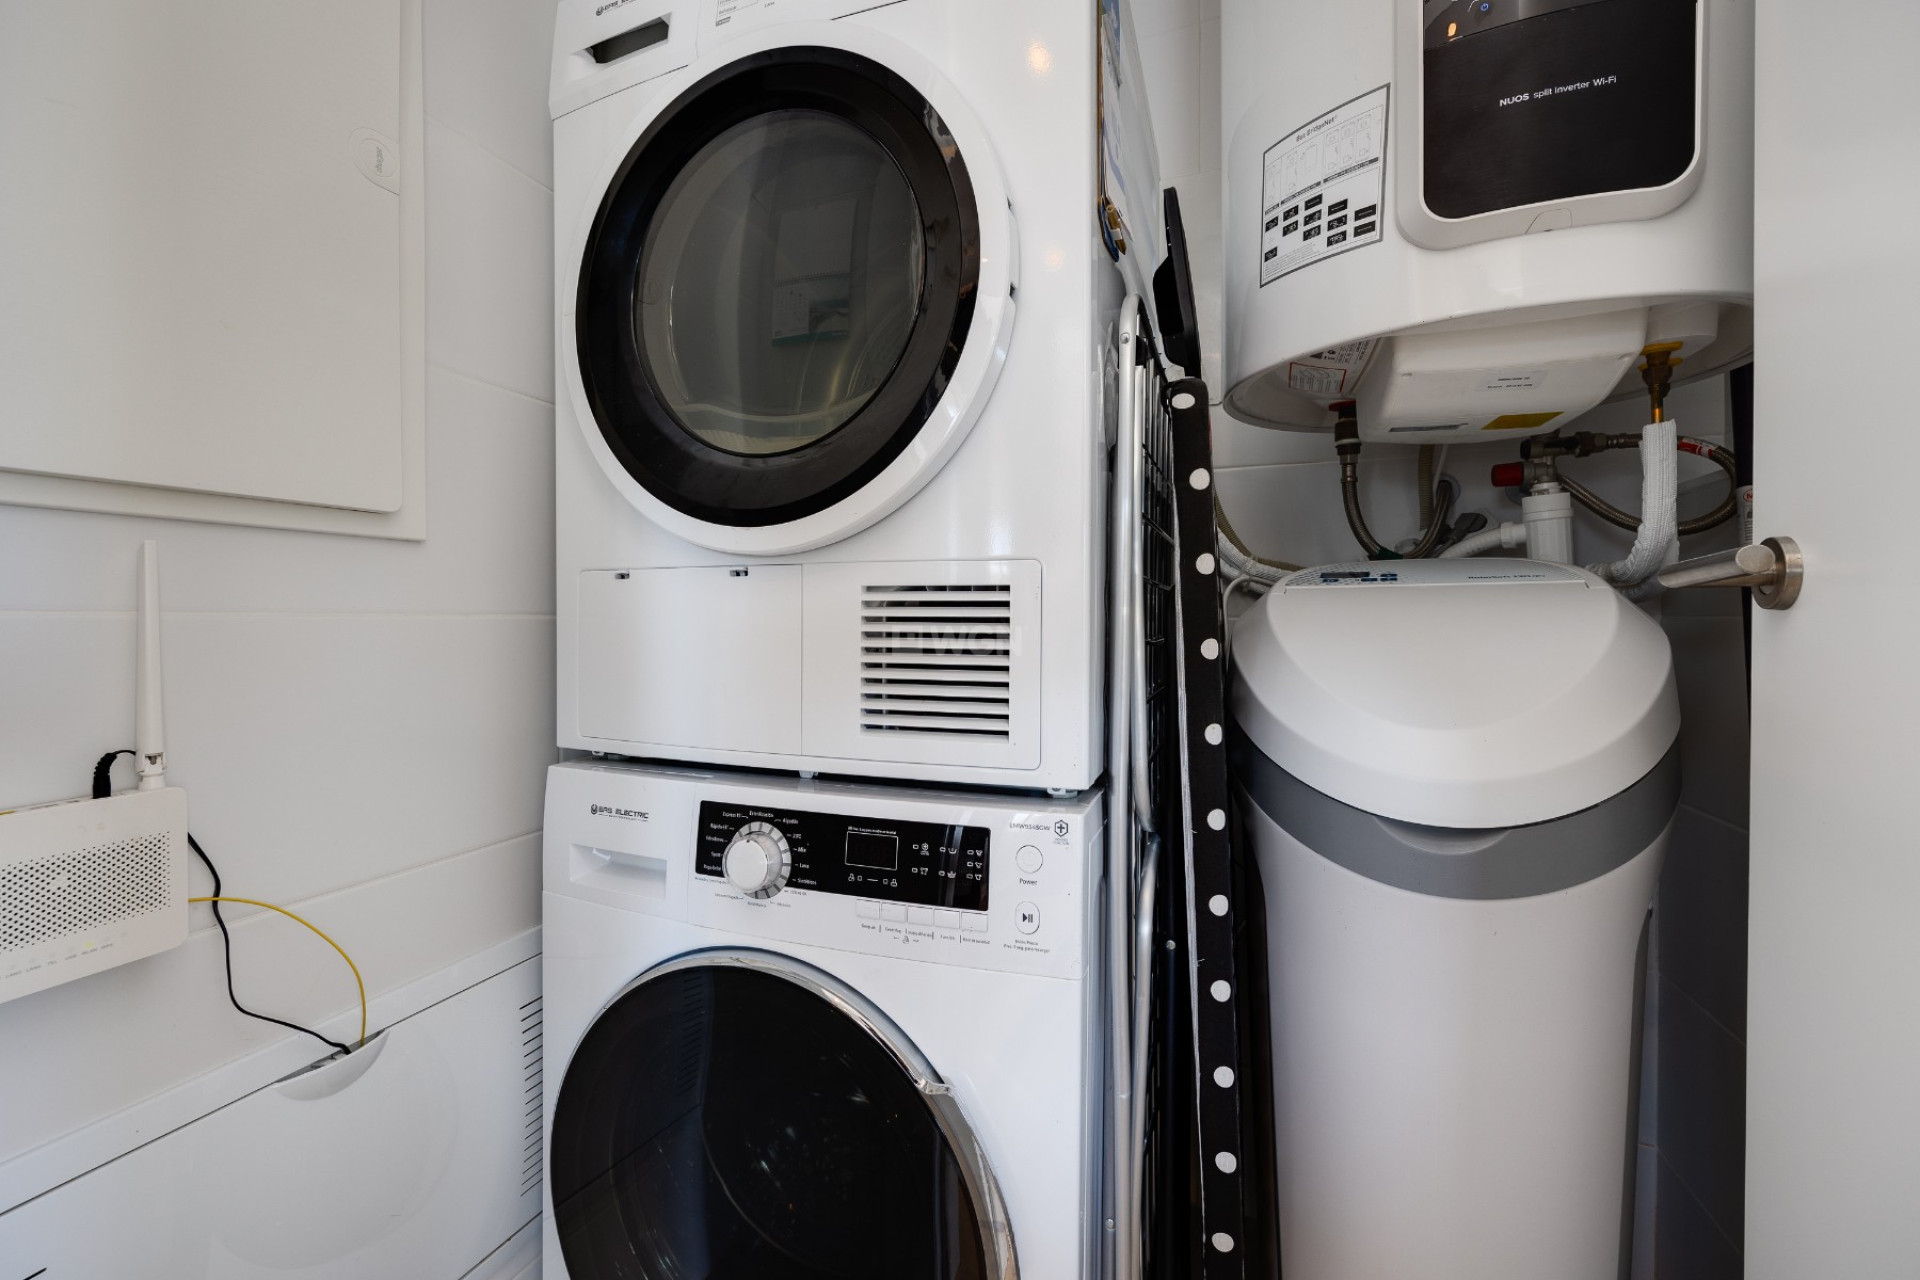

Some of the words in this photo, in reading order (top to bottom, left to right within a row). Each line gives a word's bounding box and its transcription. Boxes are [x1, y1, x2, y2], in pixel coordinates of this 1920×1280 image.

[1499, 93, 1530, 107] NUOS
[1533, 88, 1553, 99] split
[1554, 81, 1590, 95] inverter
[1592, 75, 1617, 87] Wi-Fi
[615, 808, 650, 819] ELECTRIC
[1019, 877, 1038, 886] Power
